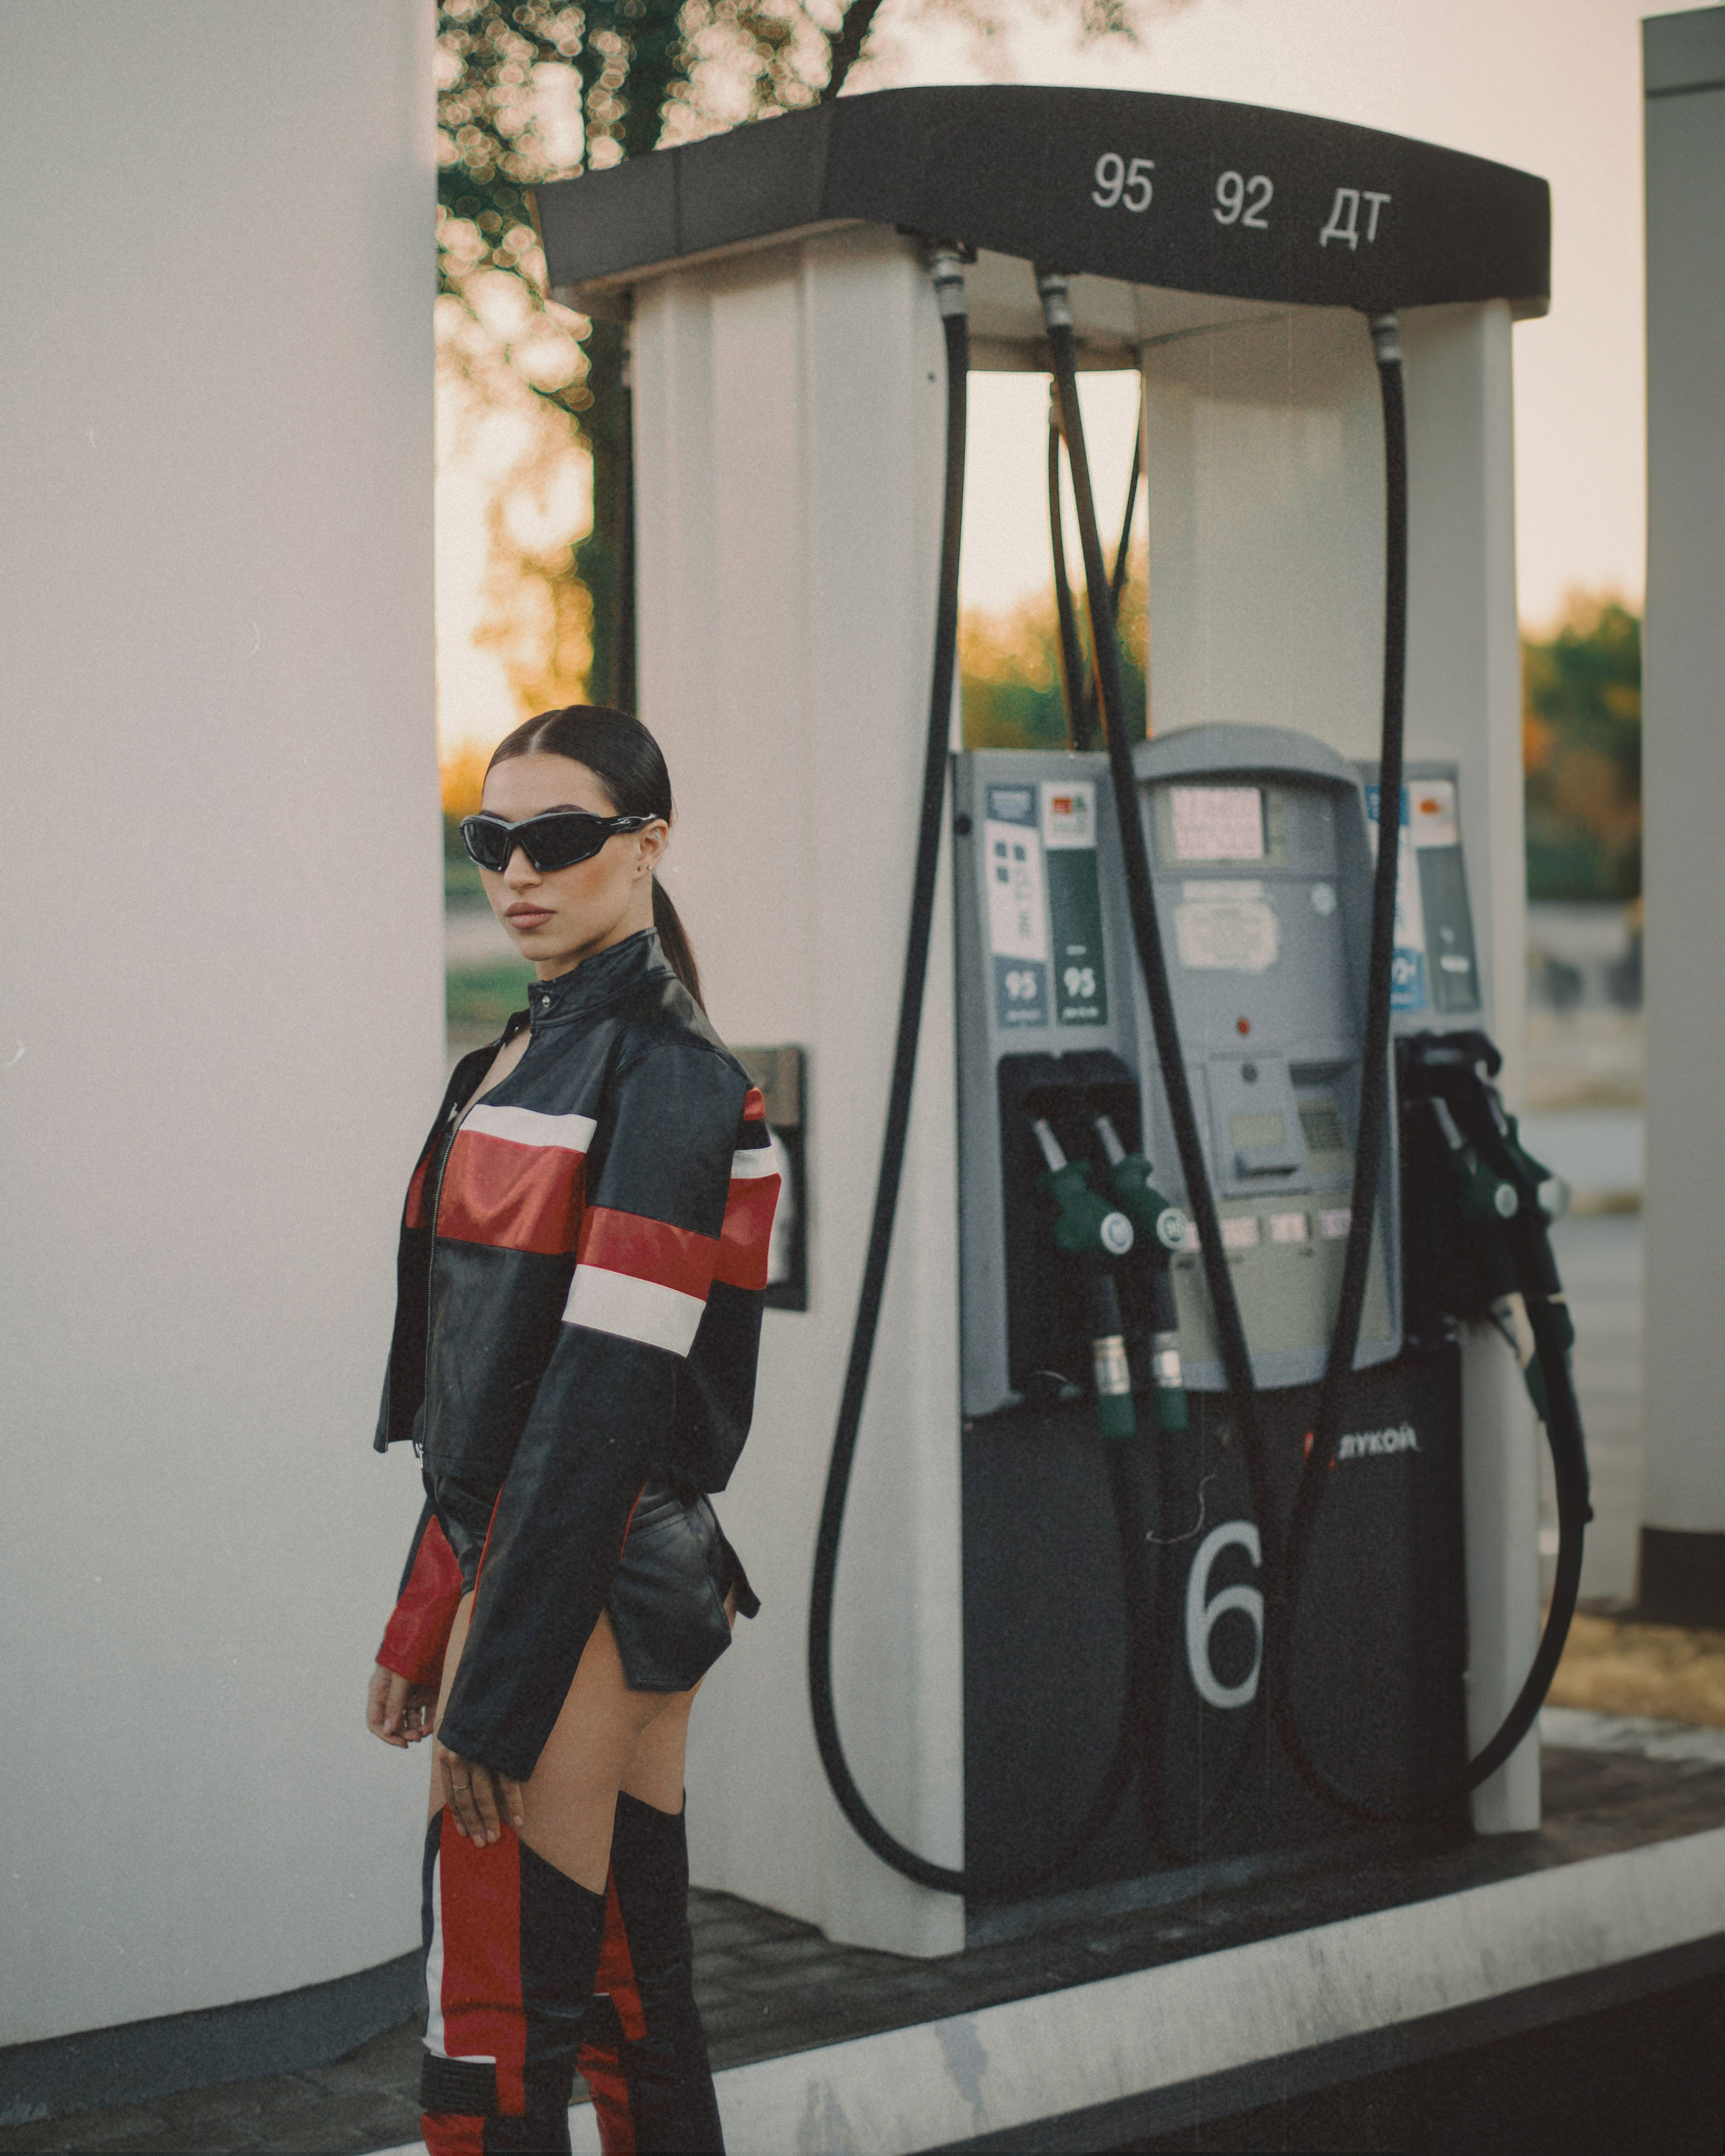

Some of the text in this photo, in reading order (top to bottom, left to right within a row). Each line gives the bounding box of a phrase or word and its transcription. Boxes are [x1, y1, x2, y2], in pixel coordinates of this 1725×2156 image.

[1092, 152, 1392, 252] 95 92 ДТ
[1005, 970, 1037, 1001] 95
[1063, 966, 1096, 998] 95
[1338, 1422, 1421, 1461] ЛУКОЙ
[1185, 1519, 1265, 1709] 6
